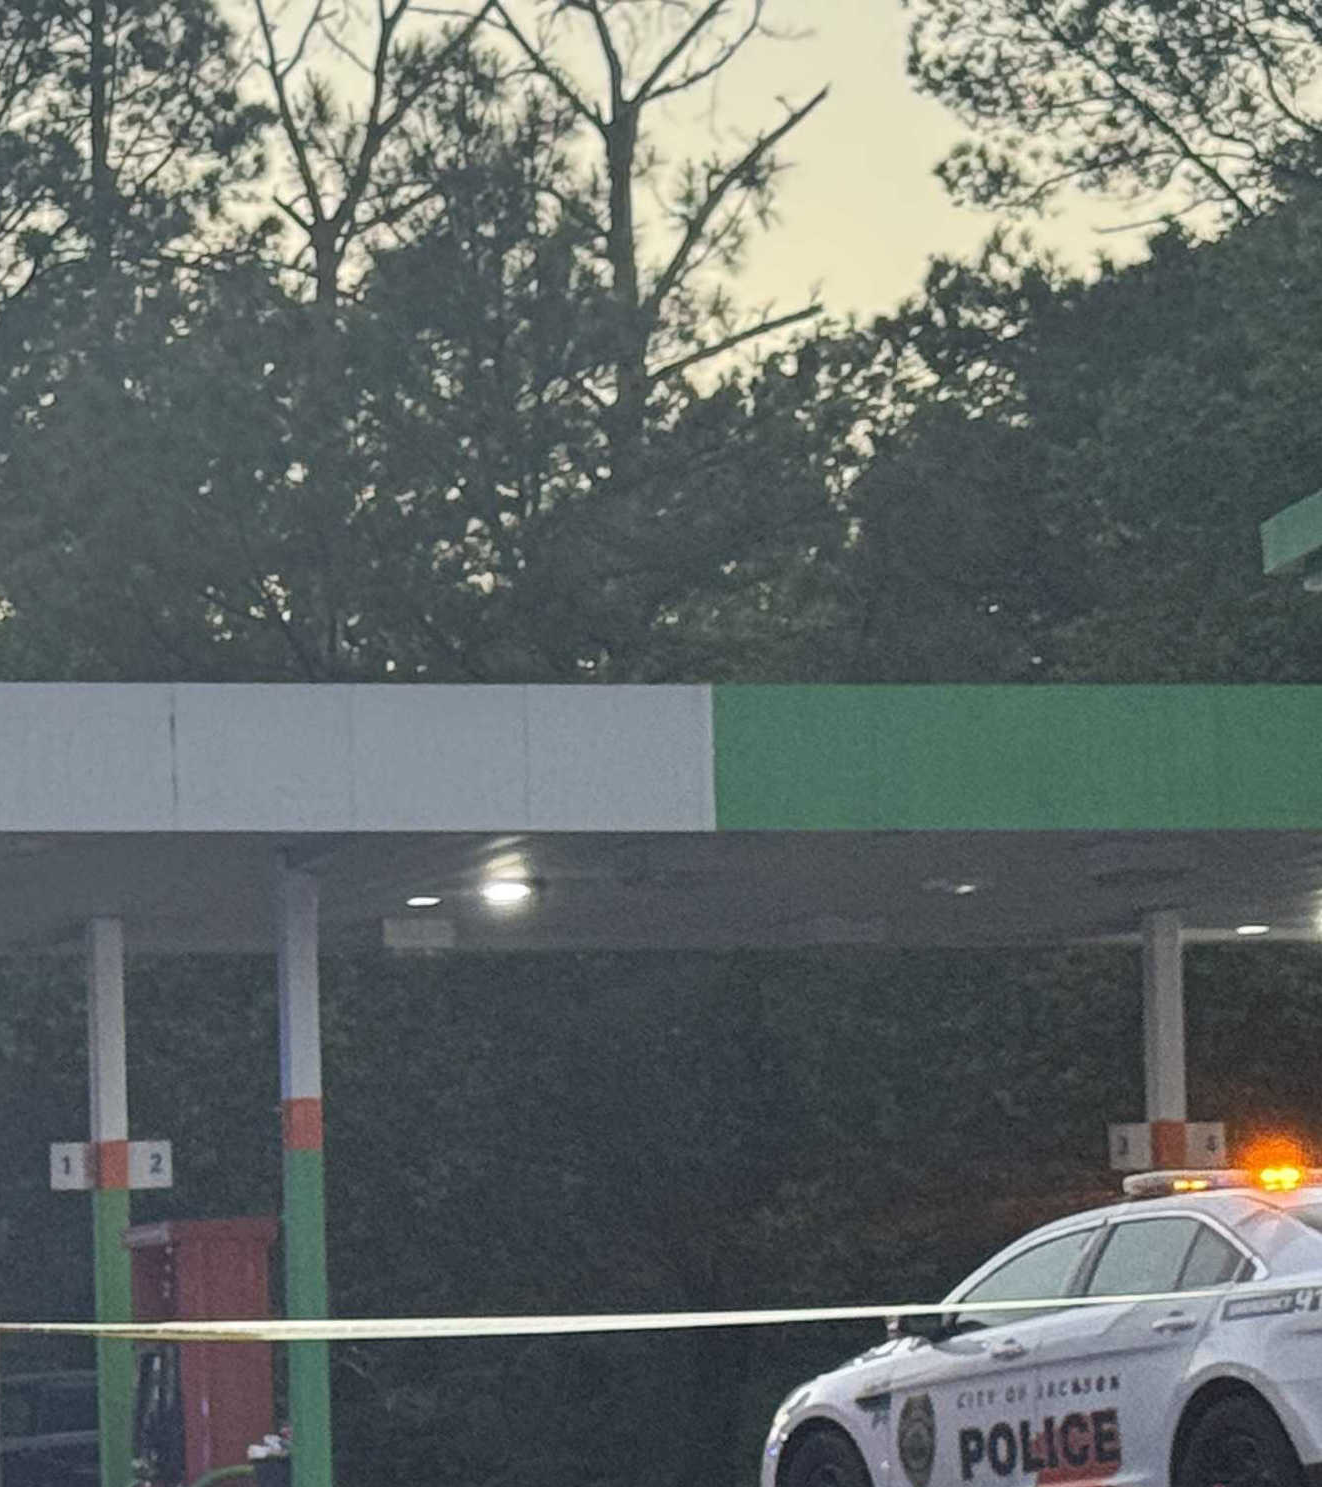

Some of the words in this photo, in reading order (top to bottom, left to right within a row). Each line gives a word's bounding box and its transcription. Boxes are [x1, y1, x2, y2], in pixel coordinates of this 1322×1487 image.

[63, 1155, 71, 1175] 1
[150, 1152, 162, 1174] 2
[958, 1389, 995, 1408] CITY
[1005, 1385, 1027, 1403] OF
[1036, 1374, 1121, 1400] JACKSON
[959, 1409, 1123, 1482] POLICE
